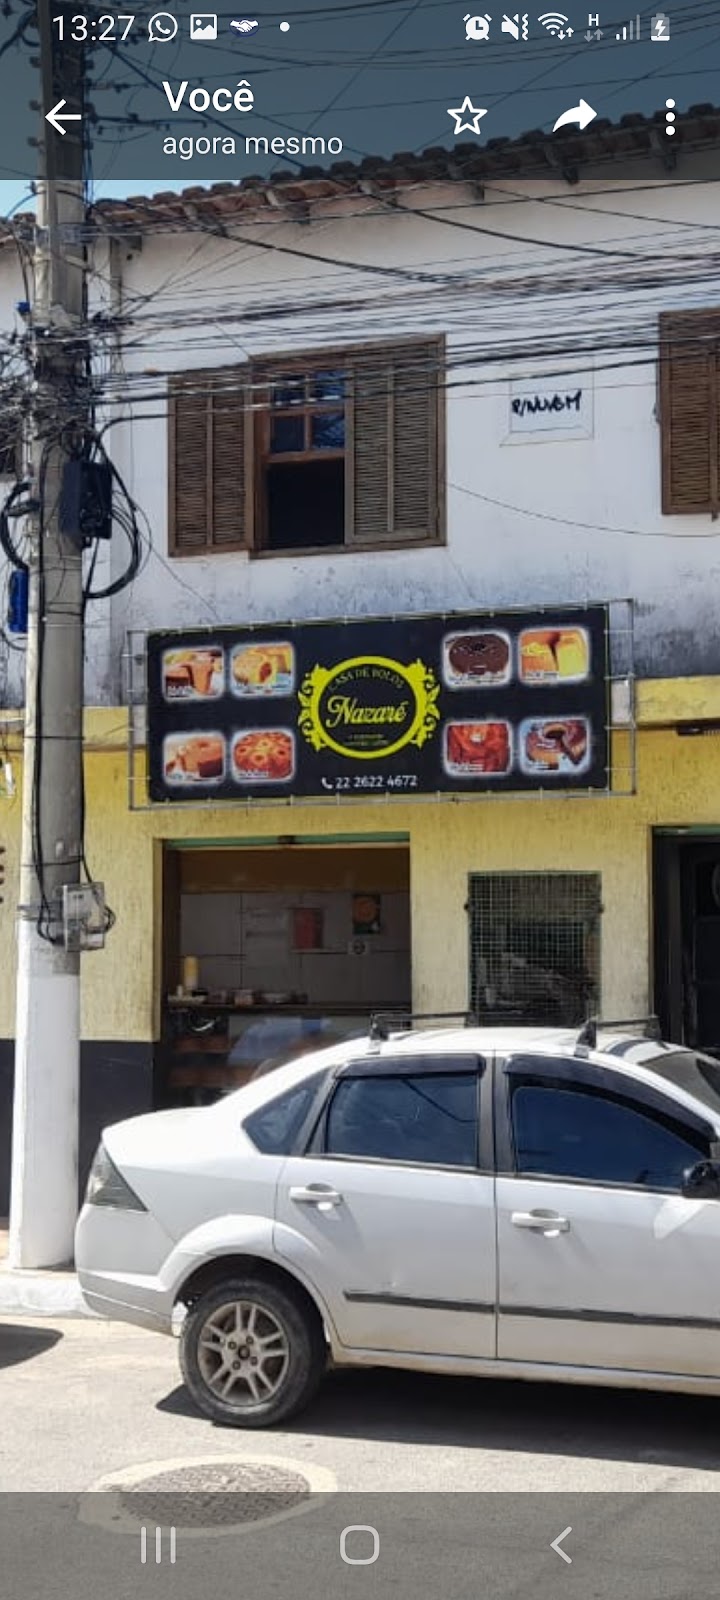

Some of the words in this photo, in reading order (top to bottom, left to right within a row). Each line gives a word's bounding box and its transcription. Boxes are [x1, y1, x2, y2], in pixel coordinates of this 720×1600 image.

[325, 695, 409, 728] Nazaré
[335, 776, 350, 789] 22
[387, 774, 417, 787] 4672
